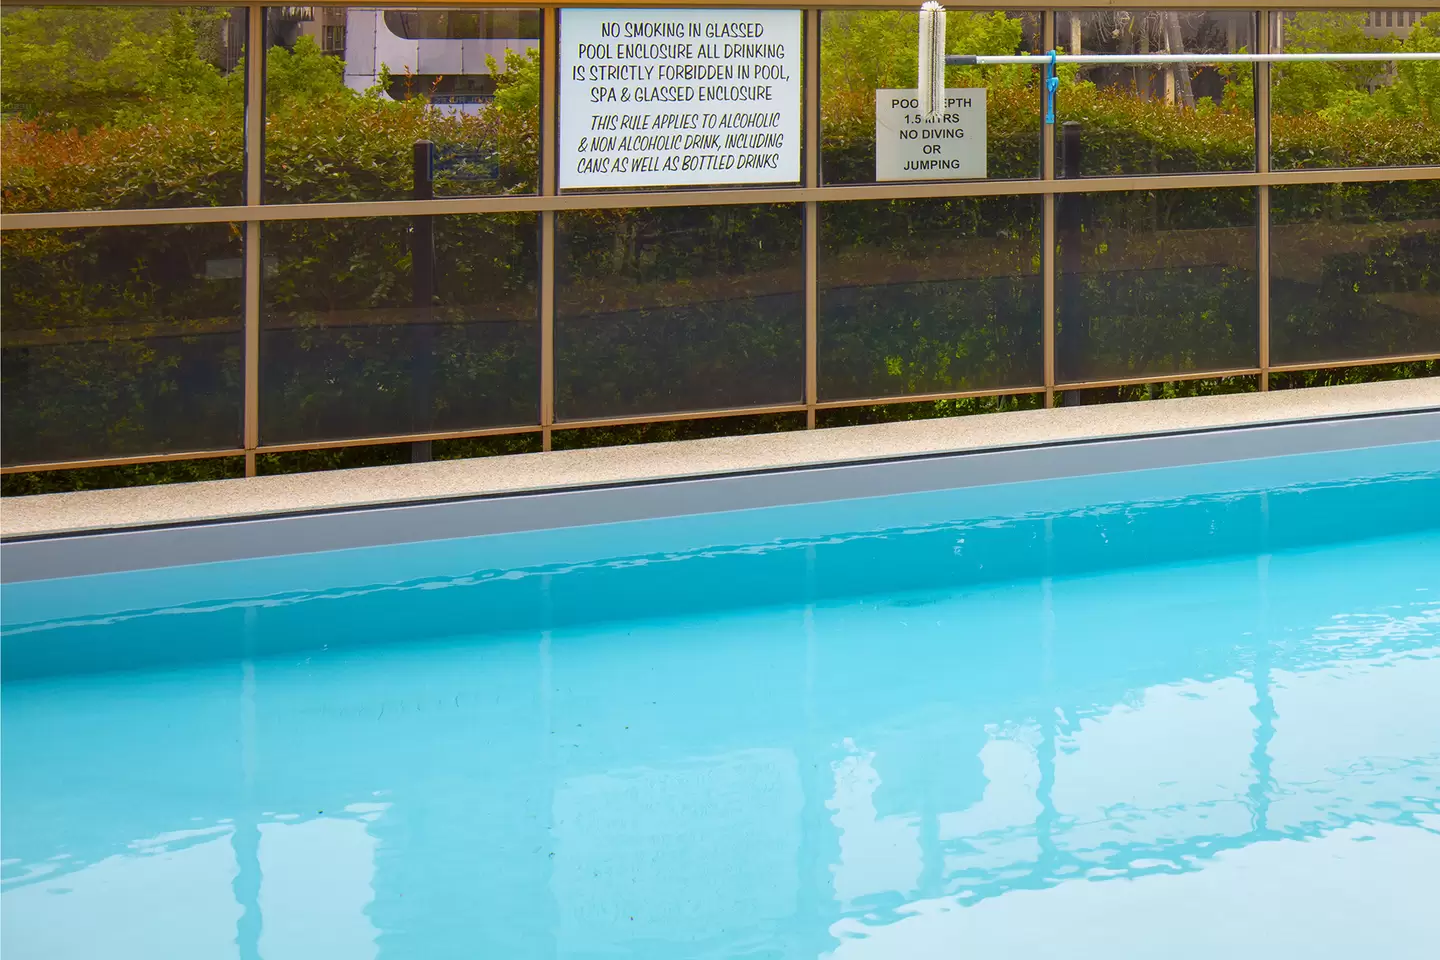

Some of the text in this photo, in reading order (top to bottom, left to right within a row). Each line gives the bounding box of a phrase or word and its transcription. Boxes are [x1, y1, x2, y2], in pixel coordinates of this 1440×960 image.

[601, 22, 764, 38] NO SMOKING IN GLASSED
[579, 43, 785, 59] POOL ENCLOSURE ALL DRINKING
[572, 64, 790, 82] IS STRICTLY FORBIDDEN IN POOL,
[590, 85, 773, 102] SPA & GLASSED ENCLOSURE
[891, 98, 919, 109] POO
[591, 112, 781, 131] THIS RULE APPLIES TO ALCOHOLIC
[904, 114, 921, 124] 1.5
[899, 128, 964, 140] NO DIVING
[577, 133, 784, 152] & NON ALCOHOLIC DRINK, INCLUDING
[922, 144, 942, 155] OR
[577, 153, 780, 174] CANS AS WELL AS BOTTLED DRINKS
[904, 159, 960, 171] JUMPING
